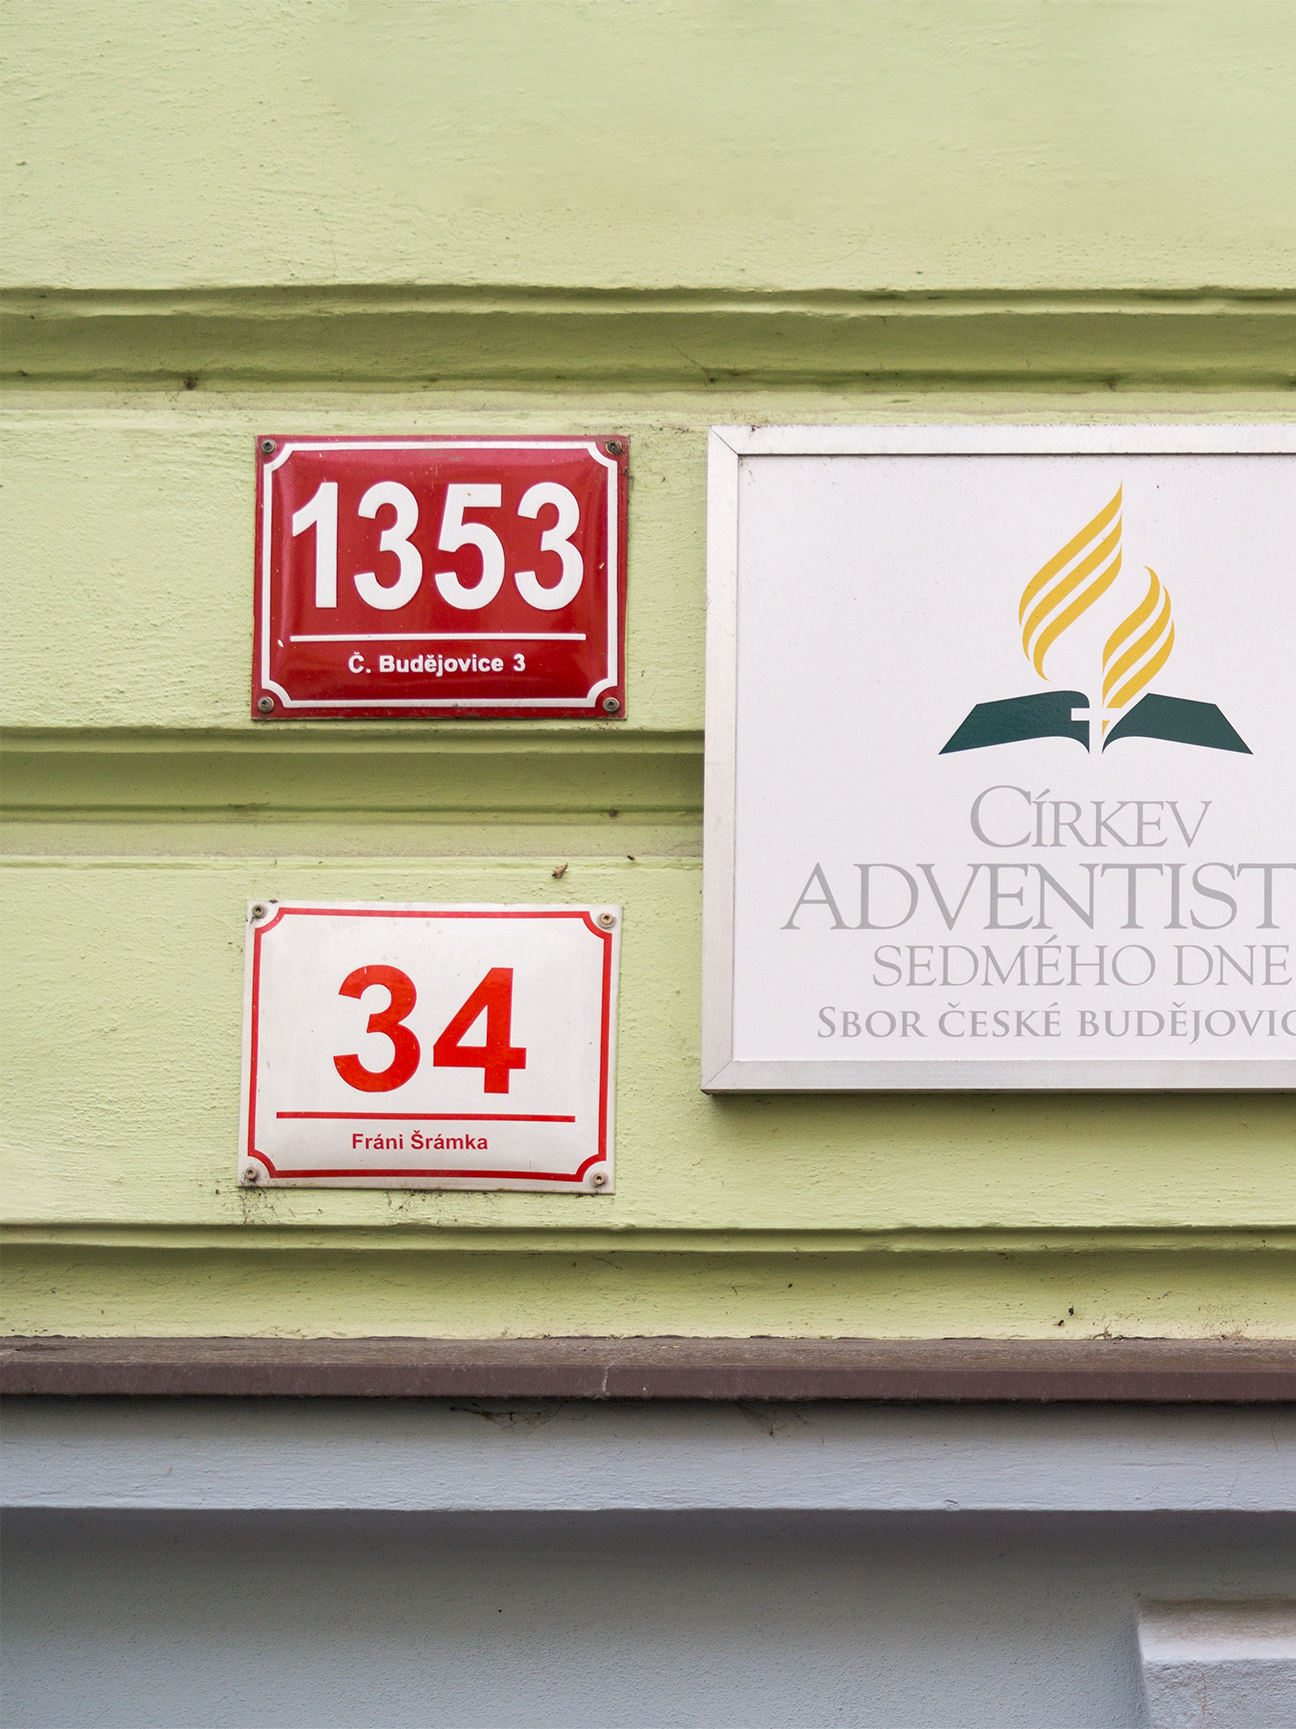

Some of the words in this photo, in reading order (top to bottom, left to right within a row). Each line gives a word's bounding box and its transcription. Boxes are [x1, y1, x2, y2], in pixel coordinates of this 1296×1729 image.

[291, 481, 585, 611] 1353
[348, 651, 371, 674] Č.
[379, 653, 504, 677] Budějovice
[512, 653, 526, 673] 3
[871, 934, 1156, 987] SEDMÉHO
[1173, 943, 1293, 987] DNE
[333, 964, 527, 1094] 34
[937, 1001, 1062, 1038] ČESKÉ
[351, 1132, 404, 1150] Fráni
[410, 1130, 489, 1151] Šrámka
